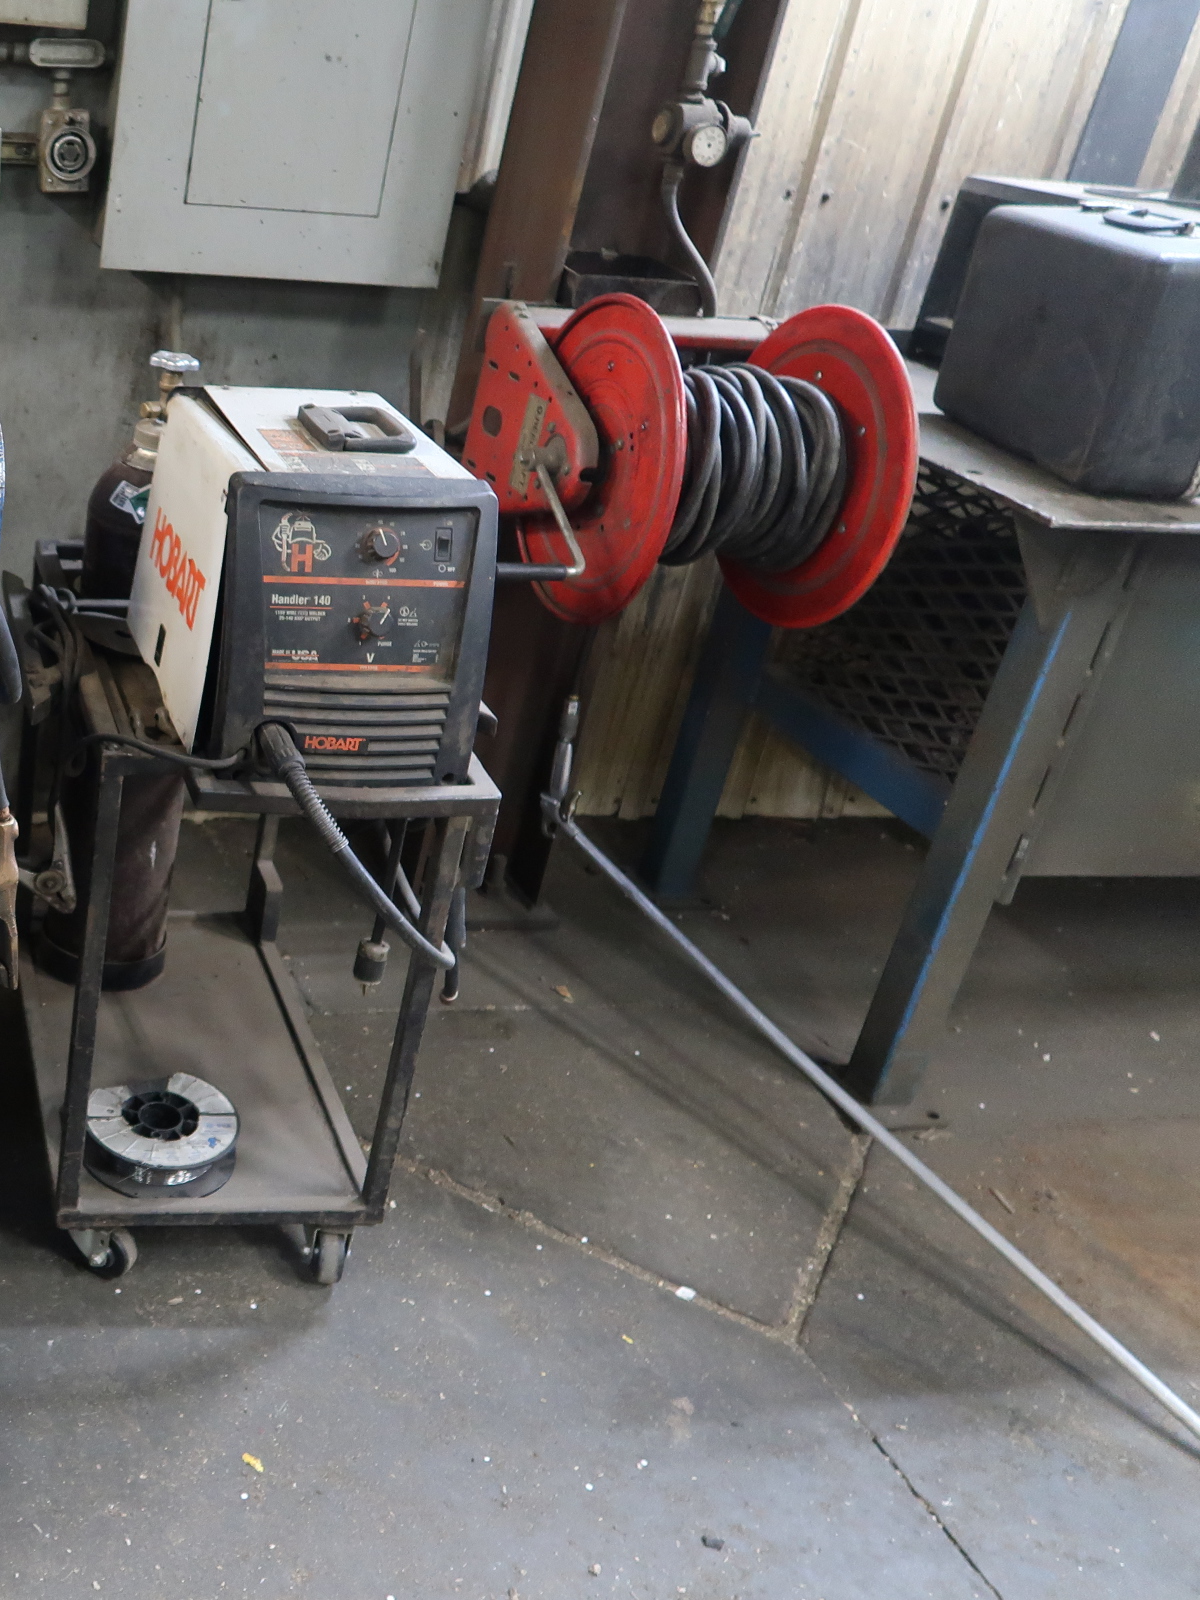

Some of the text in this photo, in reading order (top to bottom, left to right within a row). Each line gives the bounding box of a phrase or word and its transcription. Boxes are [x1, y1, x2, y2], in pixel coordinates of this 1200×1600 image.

[150, 506, 206, 631] HOBART
[271, 594, 331, 605] Handler 140
[367, 653, 375, 663] V
[305, 735, 363, 751] HOBART
